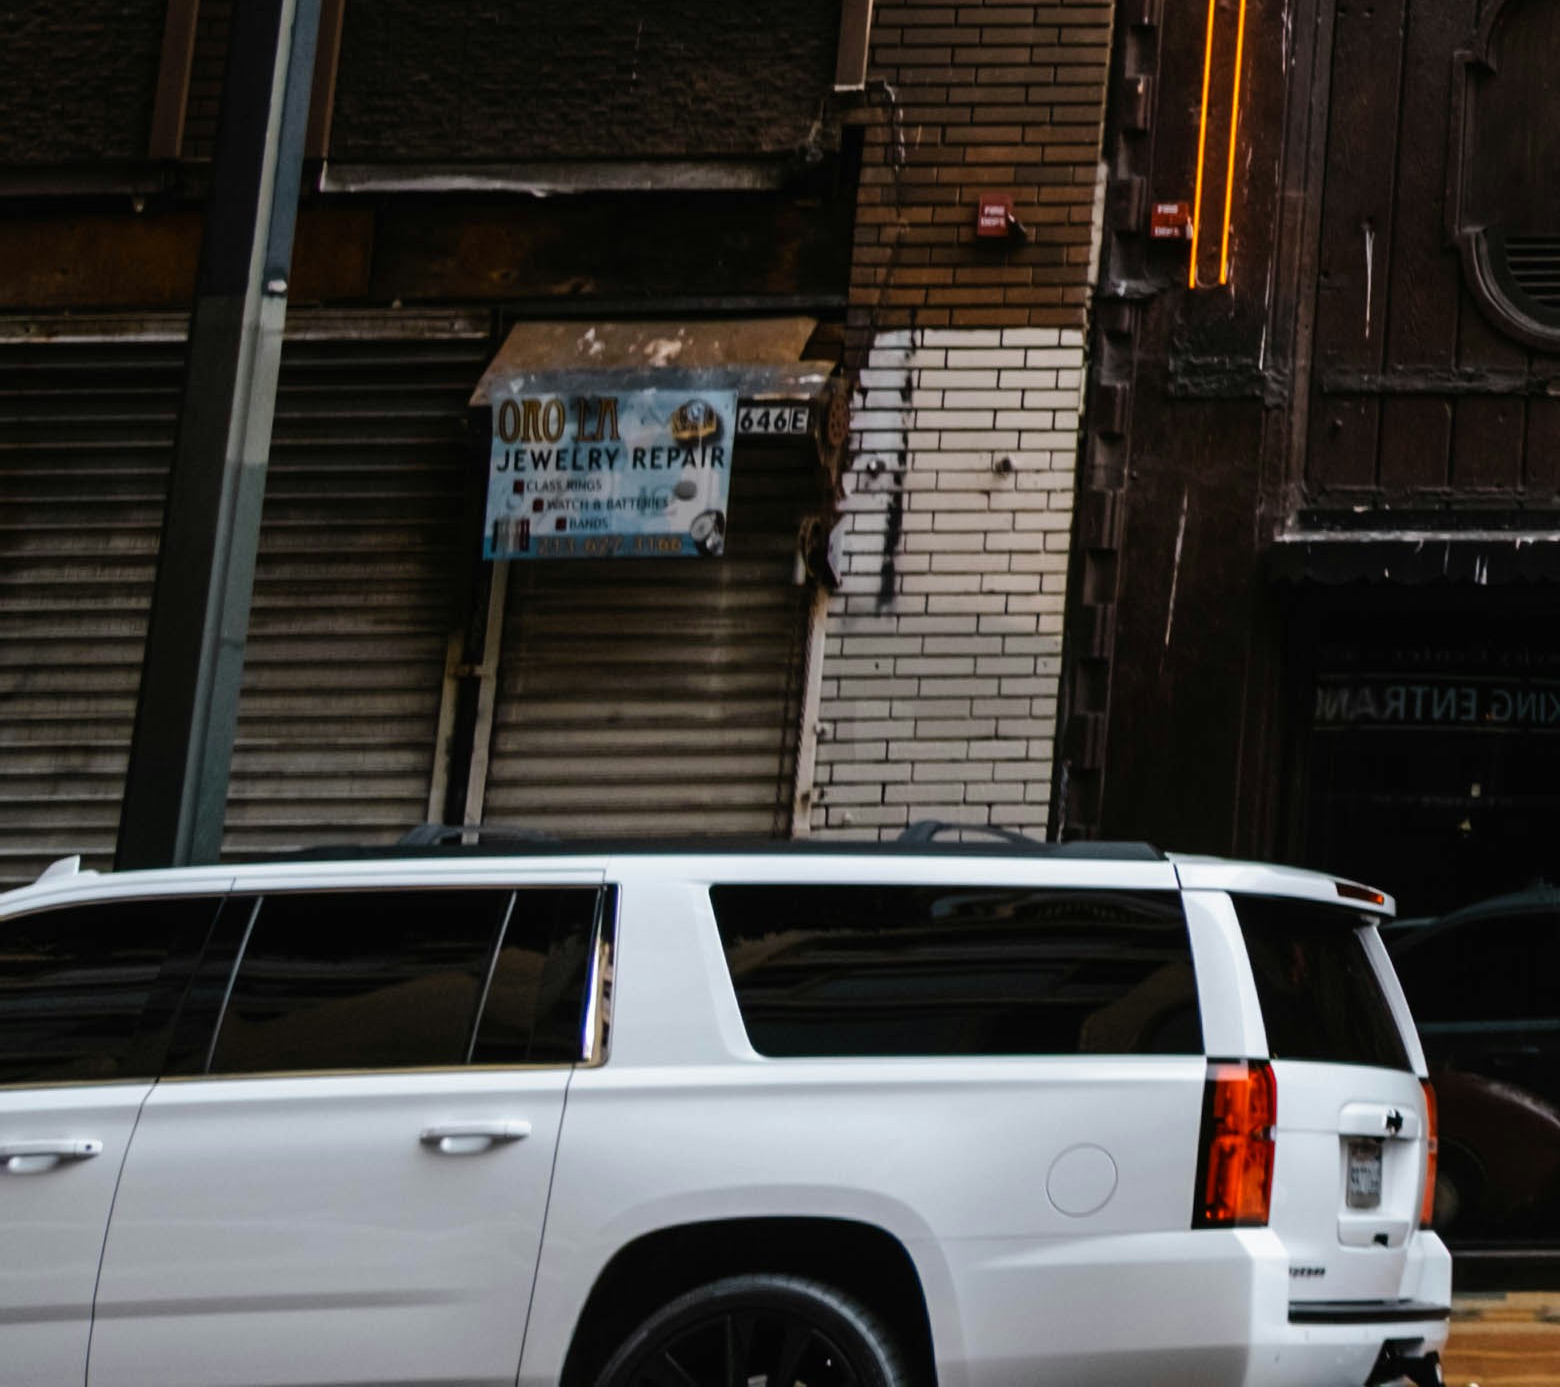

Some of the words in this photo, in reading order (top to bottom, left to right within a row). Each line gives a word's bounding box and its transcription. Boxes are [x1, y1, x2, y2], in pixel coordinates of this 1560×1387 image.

[573, 395, 621, 443] LA
[497, 447, 619, 473] JEWELRY
[632, 446, 725, 470] REPAIR
[526, 480, 562, 492] CLASS
[566, 479, 602, 491] RINGS
[547, 498, 589, 510] WATCH
[606, 497, 669, 510] BATTERIES
[569, 517, 609, 530] BANDS
